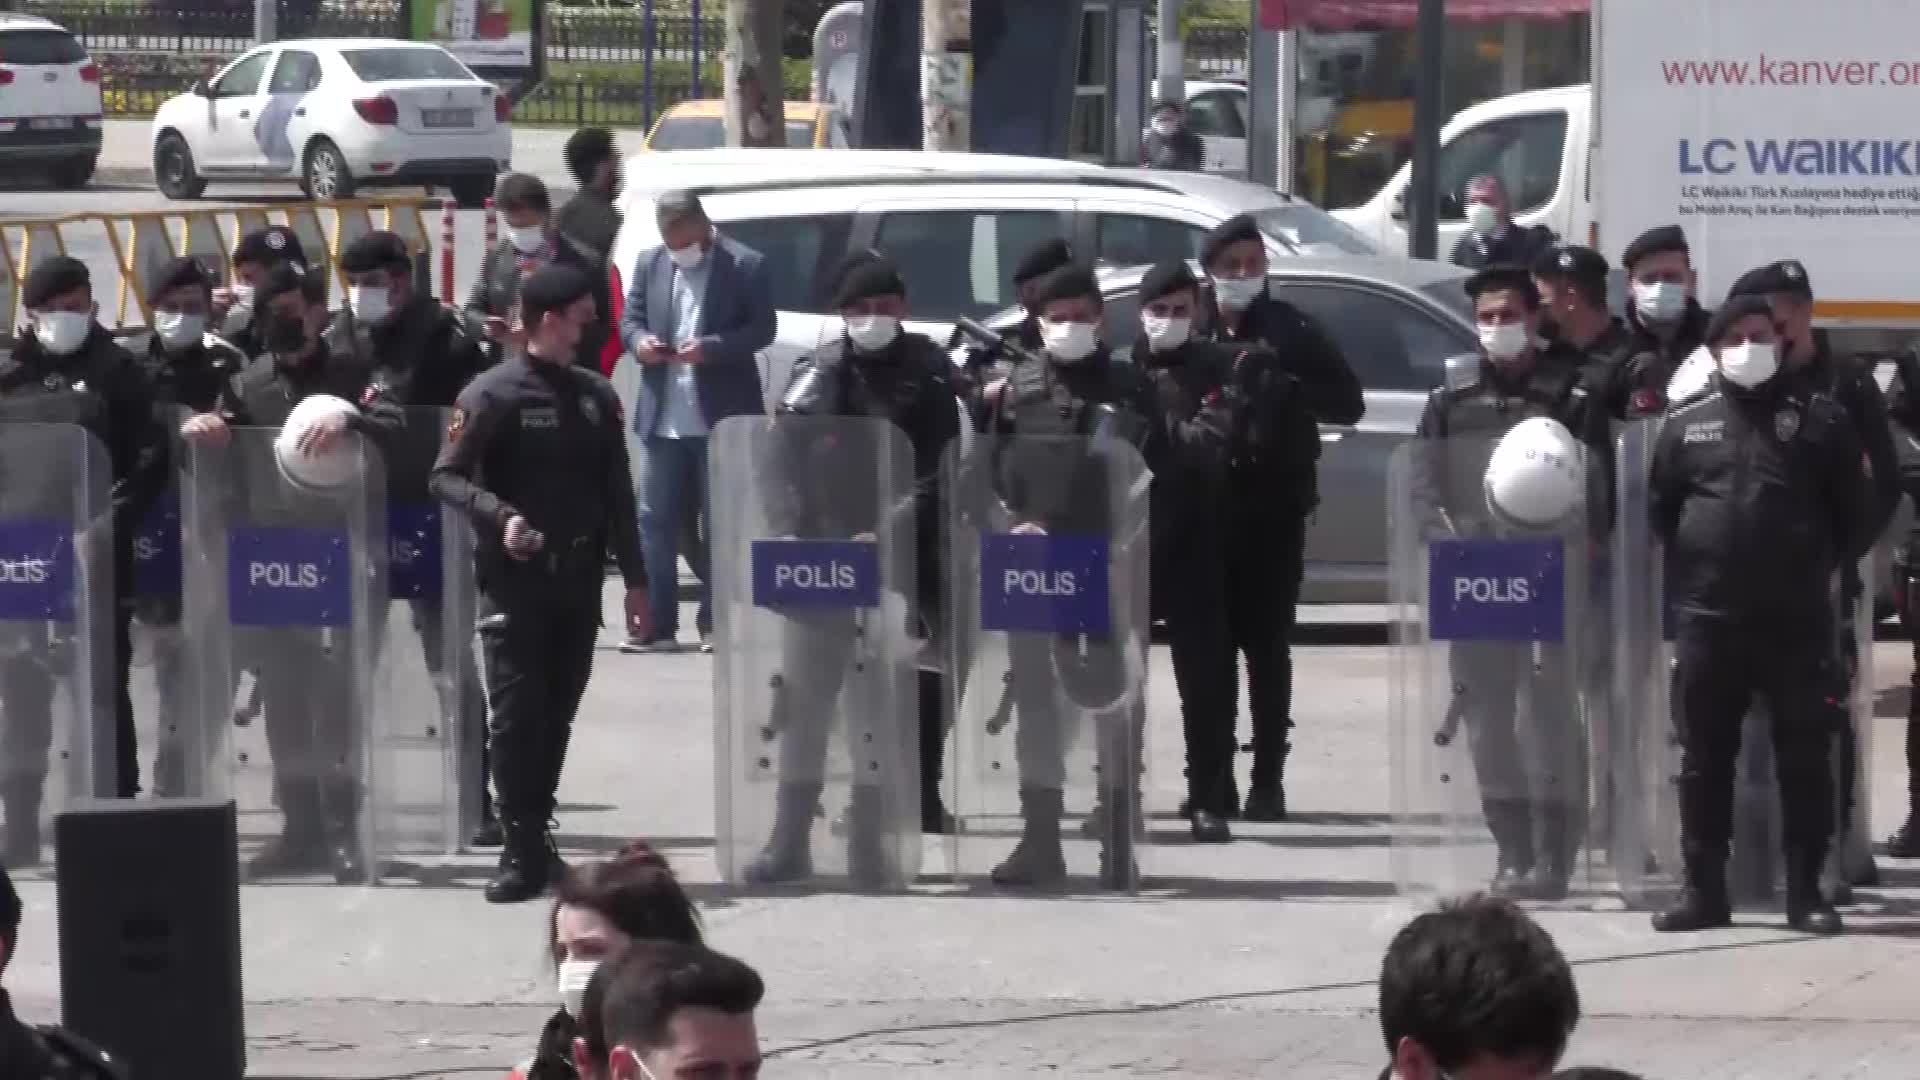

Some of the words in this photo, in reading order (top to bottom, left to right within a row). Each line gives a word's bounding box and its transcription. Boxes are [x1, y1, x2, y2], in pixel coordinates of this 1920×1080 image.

[1678, 139, 1737, 176] LC
[1681, 185, 1699, 198] LC
[1701, 185, 1747, 198] Waikiki
[1750, 185, 1777, 198] Türk
[1842, 186, 1885, 201] hediye
[1679, 204, 1694, 216] bu
[1695, 204, 1725, 216] Mobil
[1769, 204, 1792, 216] Kan
[775, 560, 856, 589] POLİS
